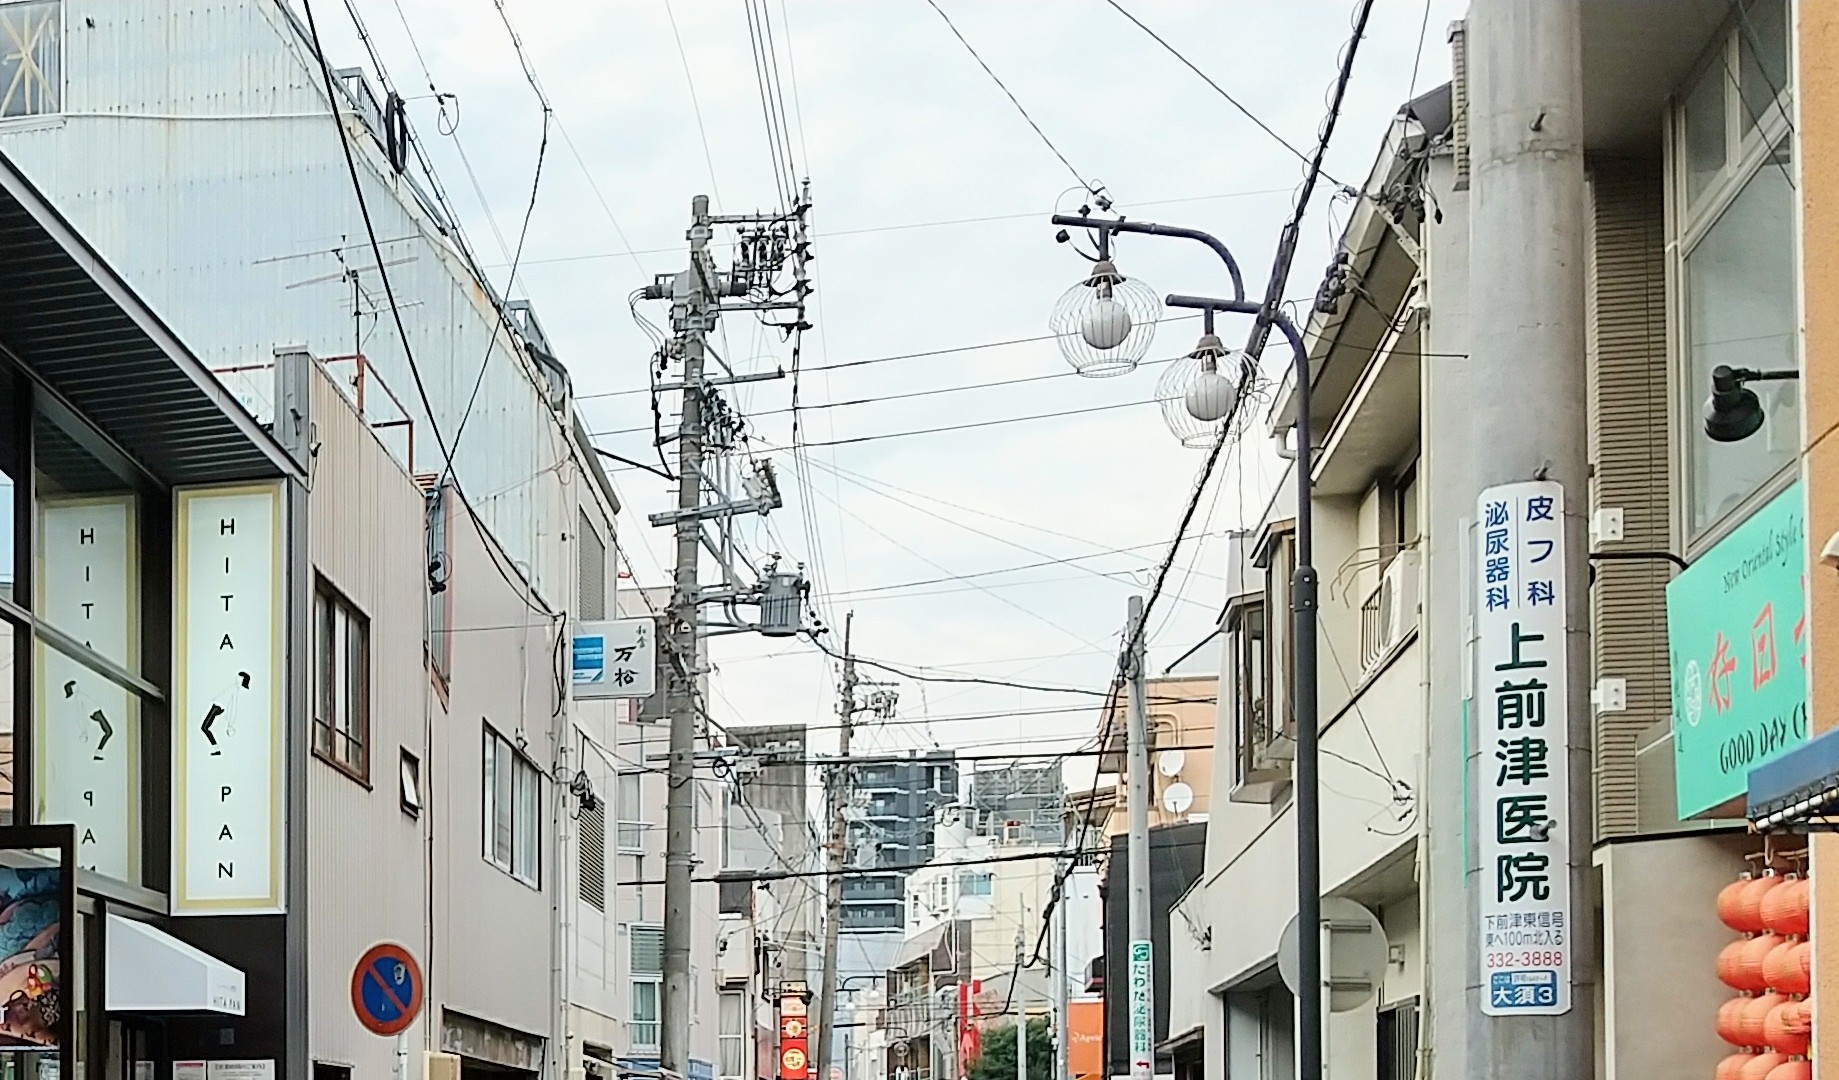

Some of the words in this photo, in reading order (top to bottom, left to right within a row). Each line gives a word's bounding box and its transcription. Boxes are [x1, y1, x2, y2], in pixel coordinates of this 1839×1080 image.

[1484, 501, 1510, 613] 泌尿器科
[1526, 496, 1555, 607] 皮フ科
[613, 646, 639, 688] 万松
[1494, 622, 1551, 903] 上前津医院
[1719, 729, 1755, 775] GOOD
[1760, 715, 1787, 758] DAY
[1487, 951, 1562, 968] 332-3888
[1493, 986, 1553, 1005] 大須3
